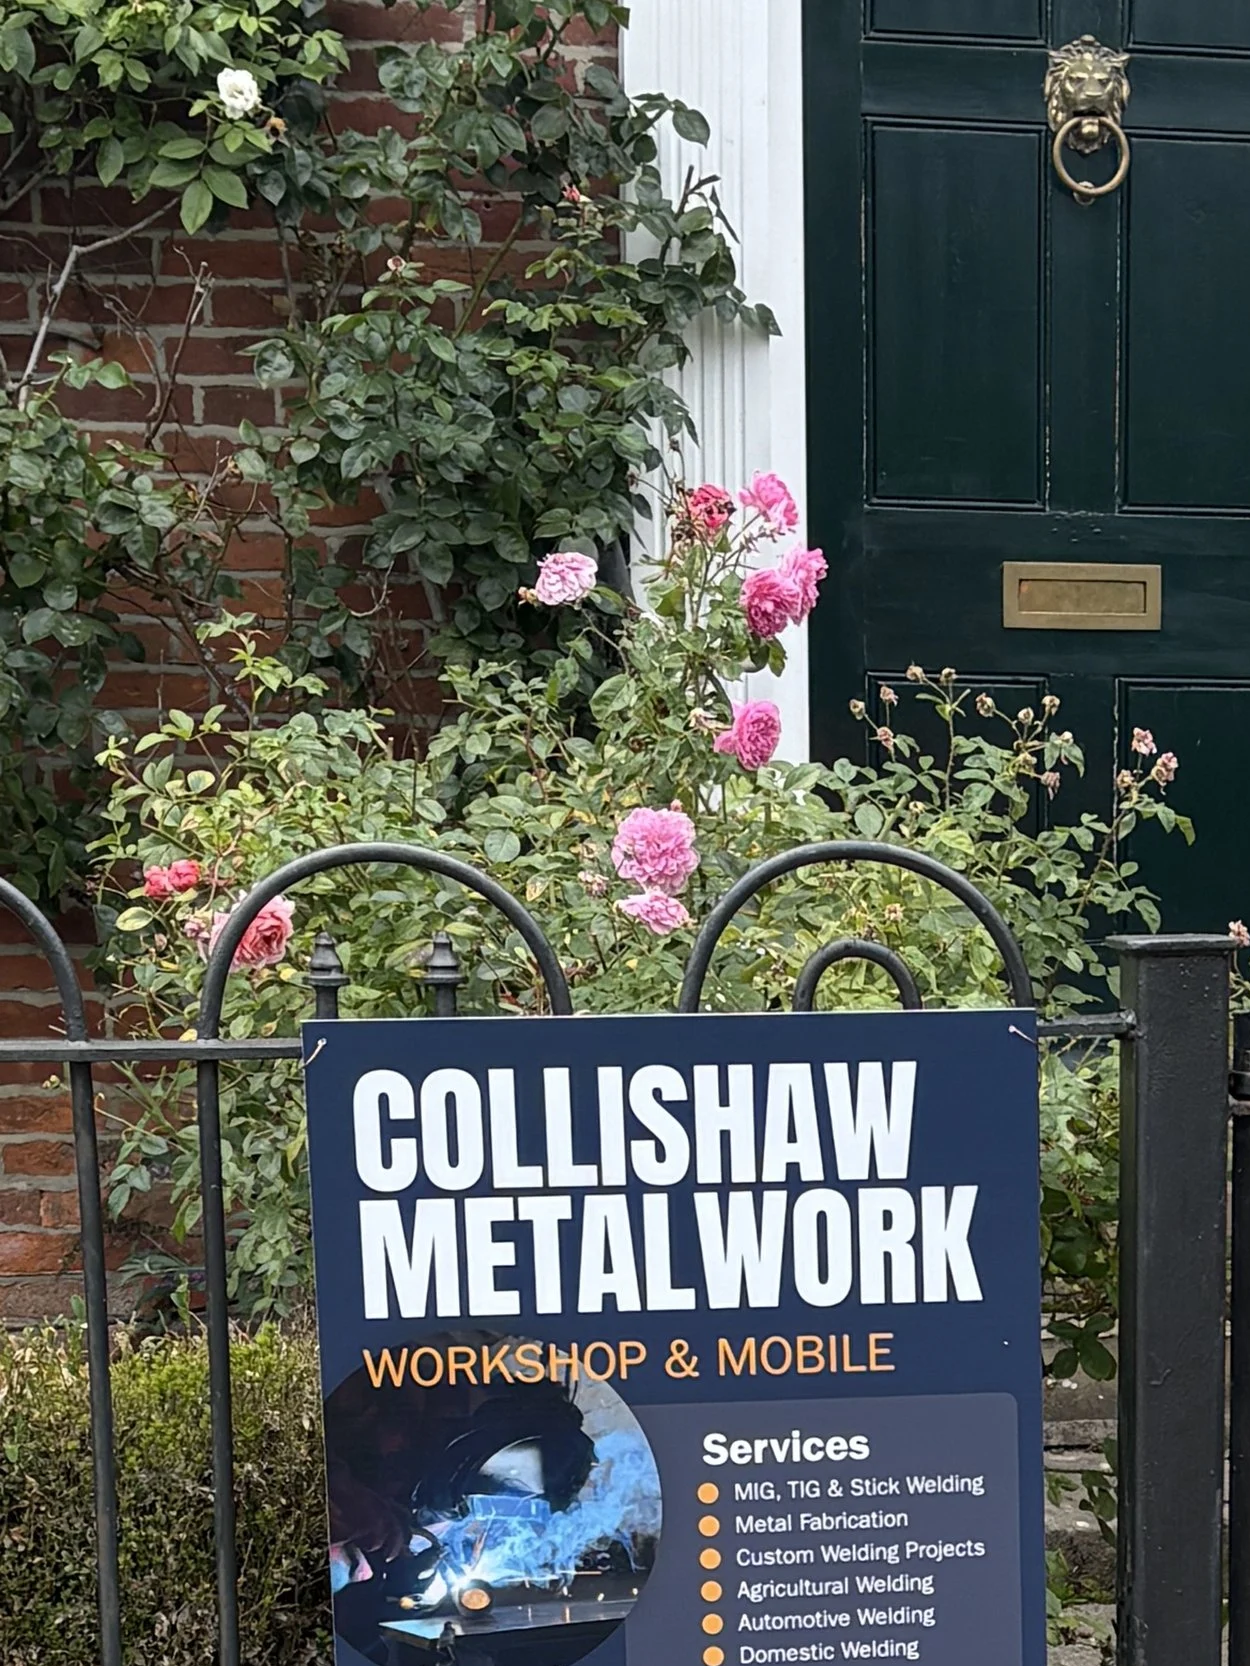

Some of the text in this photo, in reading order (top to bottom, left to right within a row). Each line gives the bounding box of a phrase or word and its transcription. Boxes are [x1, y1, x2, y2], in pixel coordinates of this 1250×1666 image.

[352, 1060, 918, 1193] COLLISHAW
[358, 1185, 984, 1320] METALWORK
[362, 1332, 896, 1389] WORKSHOP & MOBILE
[702, 1430, 870, 1466] Services
[734, 1474, 985, 1502] MIG, TIG & Stick Welding
[735, 1510, 909, 1534] Metal Fabrication
[736, 1539, 986, 1567] Custom Welding Projects
[737, 1573, 935, 1602] Agricultural Welding
[737, 1606, 936, 1633] Automotive Welding
[739, 1639, 920, 1665] Domestic Welding
